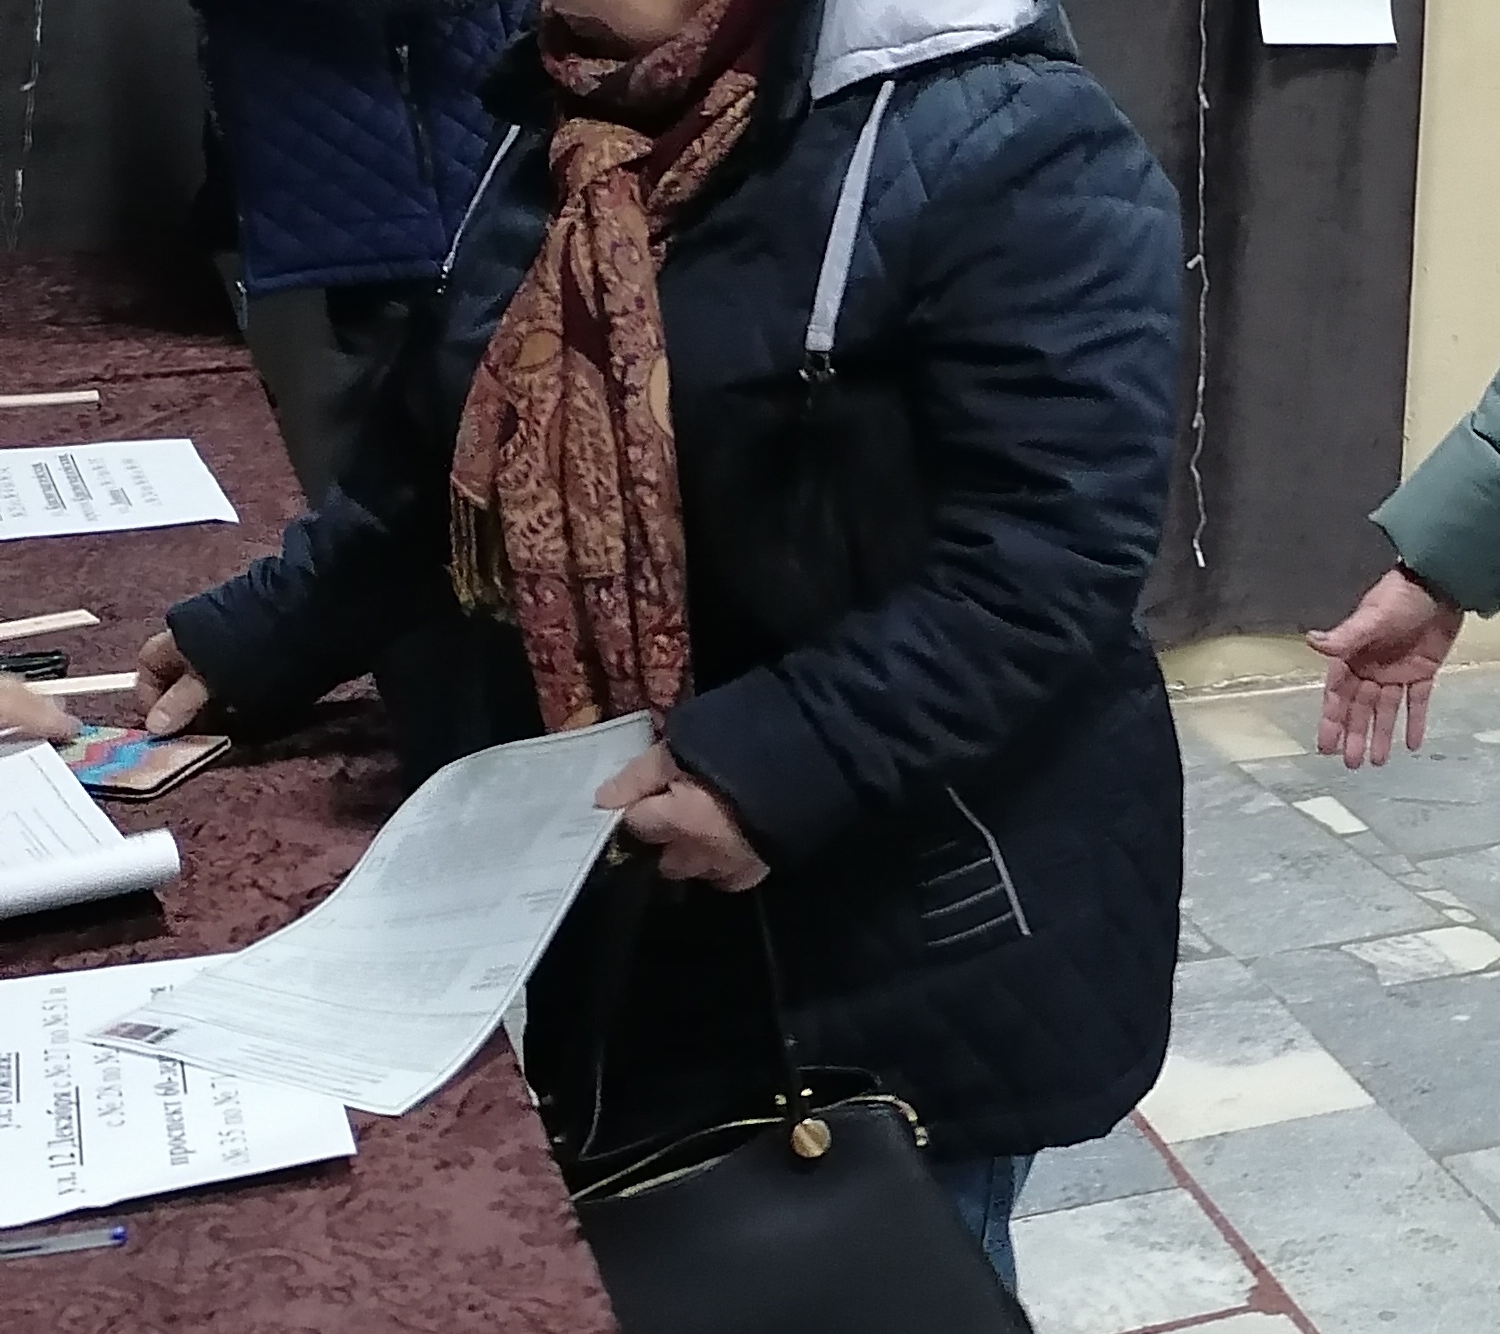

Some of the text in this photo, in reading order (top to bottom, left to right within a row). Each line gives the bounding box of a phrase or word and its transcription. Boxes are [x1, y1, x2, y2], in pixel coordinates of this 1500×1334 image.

[46, 1091, 79, 1150] Декабря
[164, 1100, 196, 1167] проспект
[48, 1153, 76, 1169] 12
[57, 1171, 86, 1196] ул.
